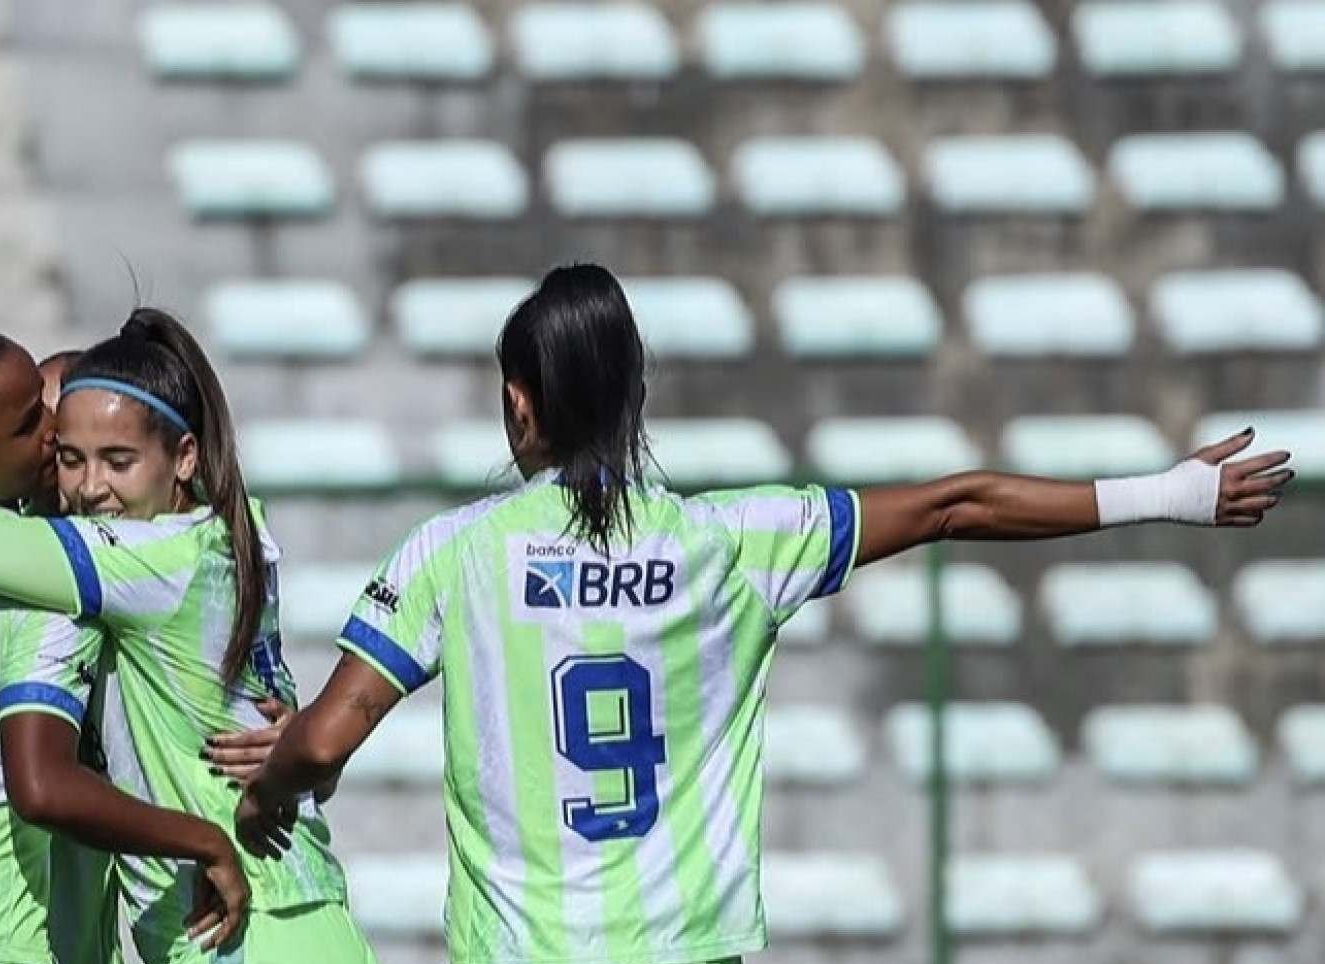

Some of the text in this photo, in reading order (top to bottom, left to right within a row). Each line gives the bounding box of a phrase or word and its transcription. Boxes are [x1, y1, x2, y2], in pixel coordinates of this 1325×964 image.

[526, 544, 575, 556] banco
[579, 560, 674, 608] BRB
[551, 653, 666, 843] 9
